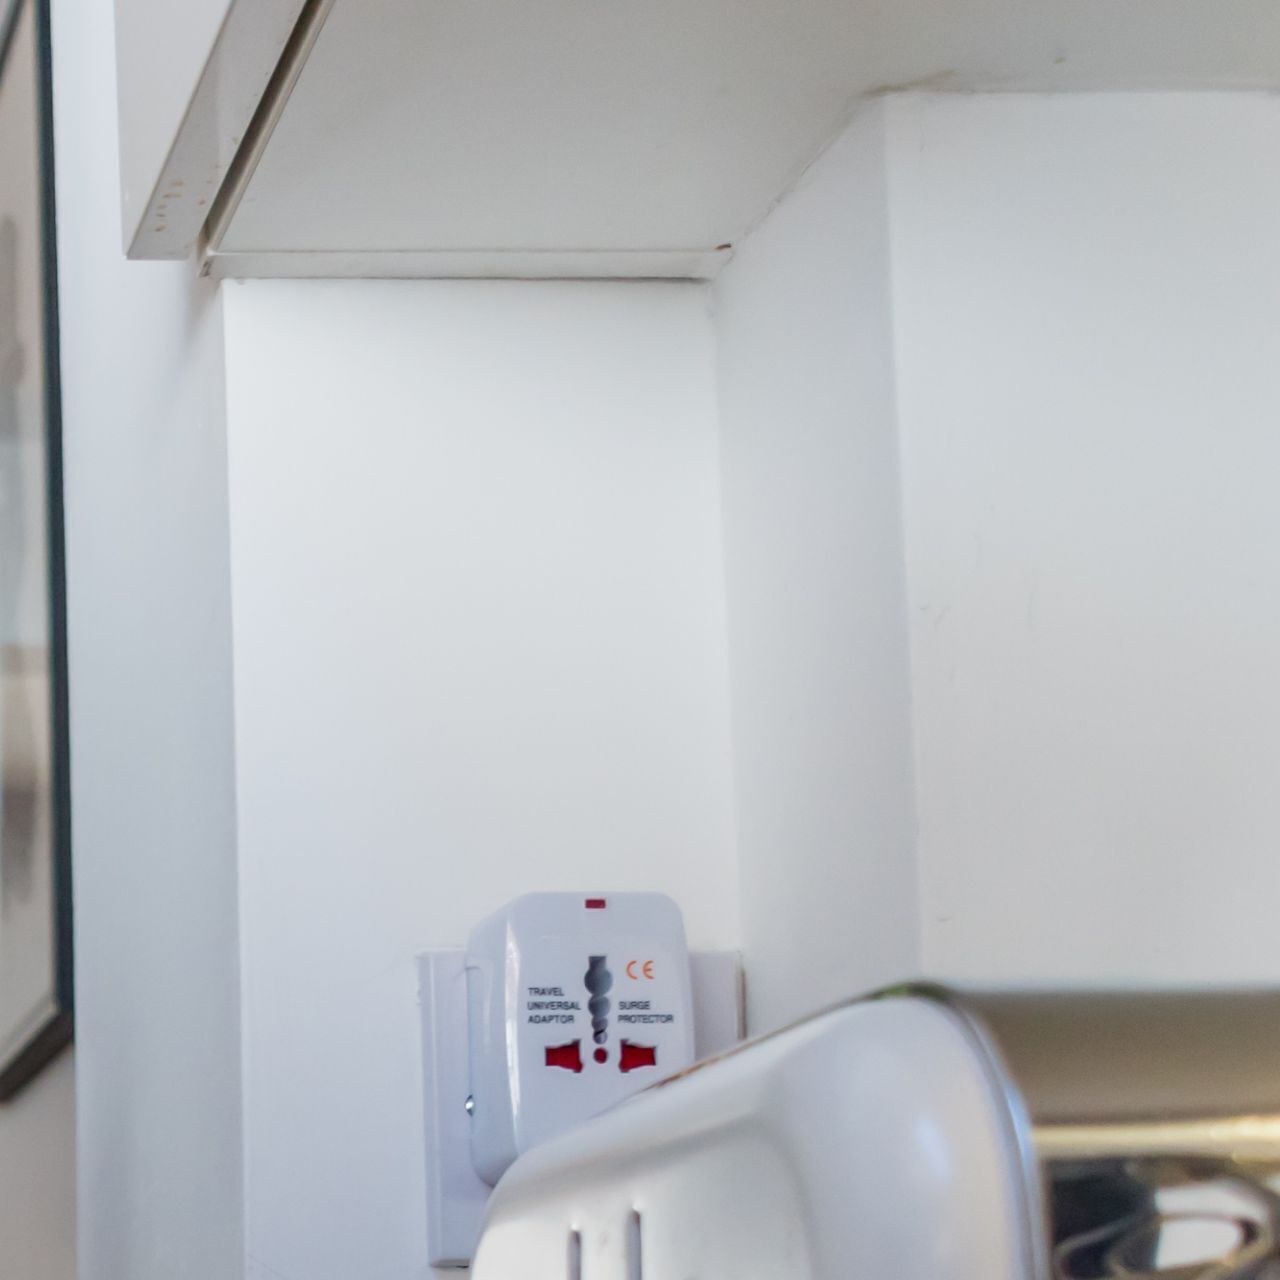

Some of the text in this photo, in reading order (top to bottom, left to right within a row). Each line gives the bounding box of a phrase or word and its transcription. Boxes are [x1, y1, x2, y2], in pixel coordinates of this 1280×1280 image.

[626, 960, 655, 980] CE
[528, 987, 564, 997] TRAVEL
[527, 1002, 581, 1011] UNIVERSAL
[618, 1001, 651, 1011] SURGE
[528, 1015, 575, 1024] ADAPTOR
[618, 1015, 674, 1024] PROTECTOR
